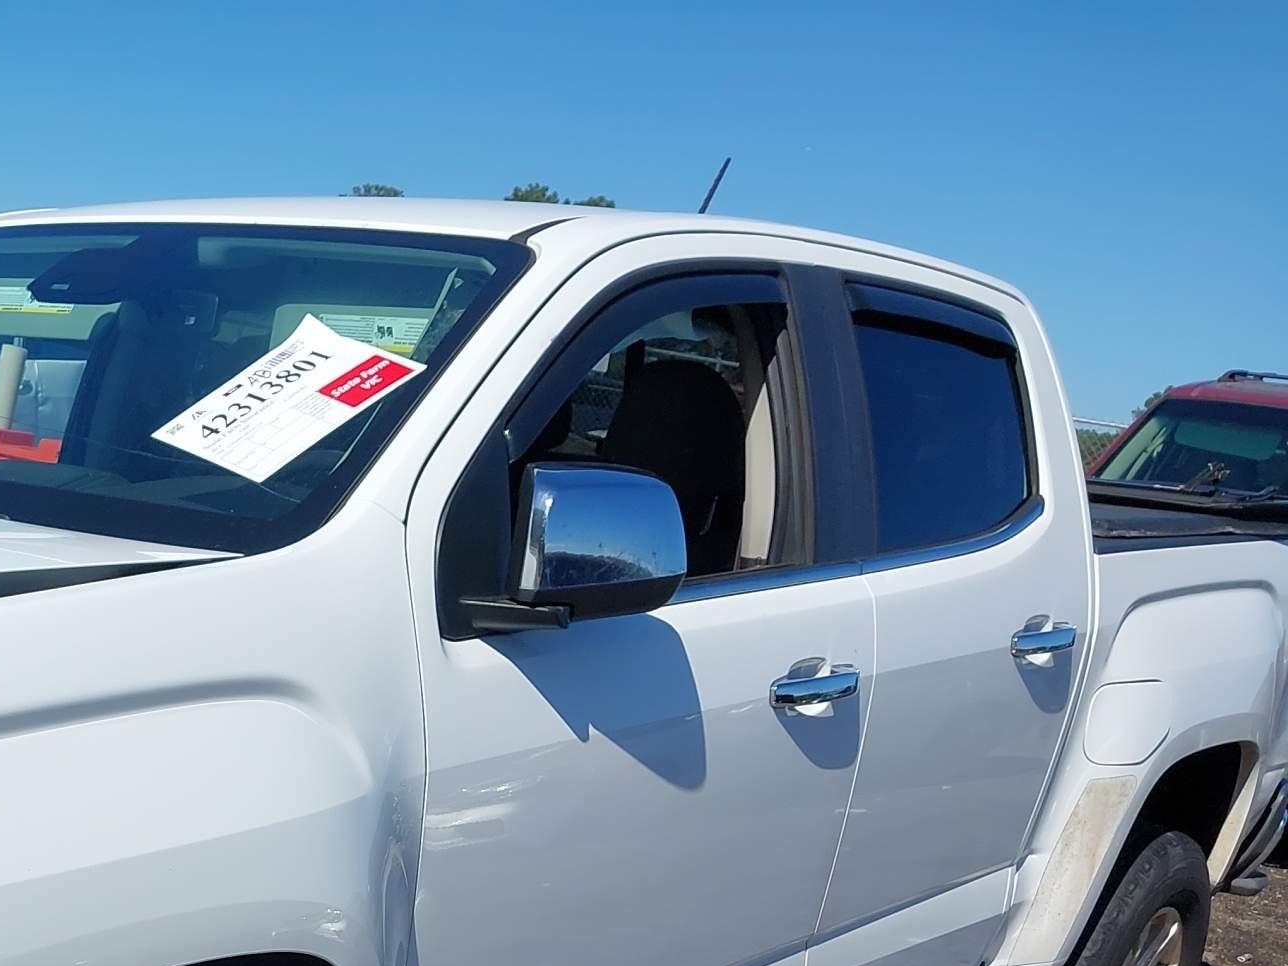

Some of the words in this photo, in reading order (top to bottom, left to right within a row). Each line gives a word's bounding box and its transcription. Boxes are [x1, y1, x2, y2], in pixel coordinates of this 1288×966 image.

[201, 350, 333, 441] 42313801
[331, 376, 361, 397] State
[359, 359, 391, 379] Farm
